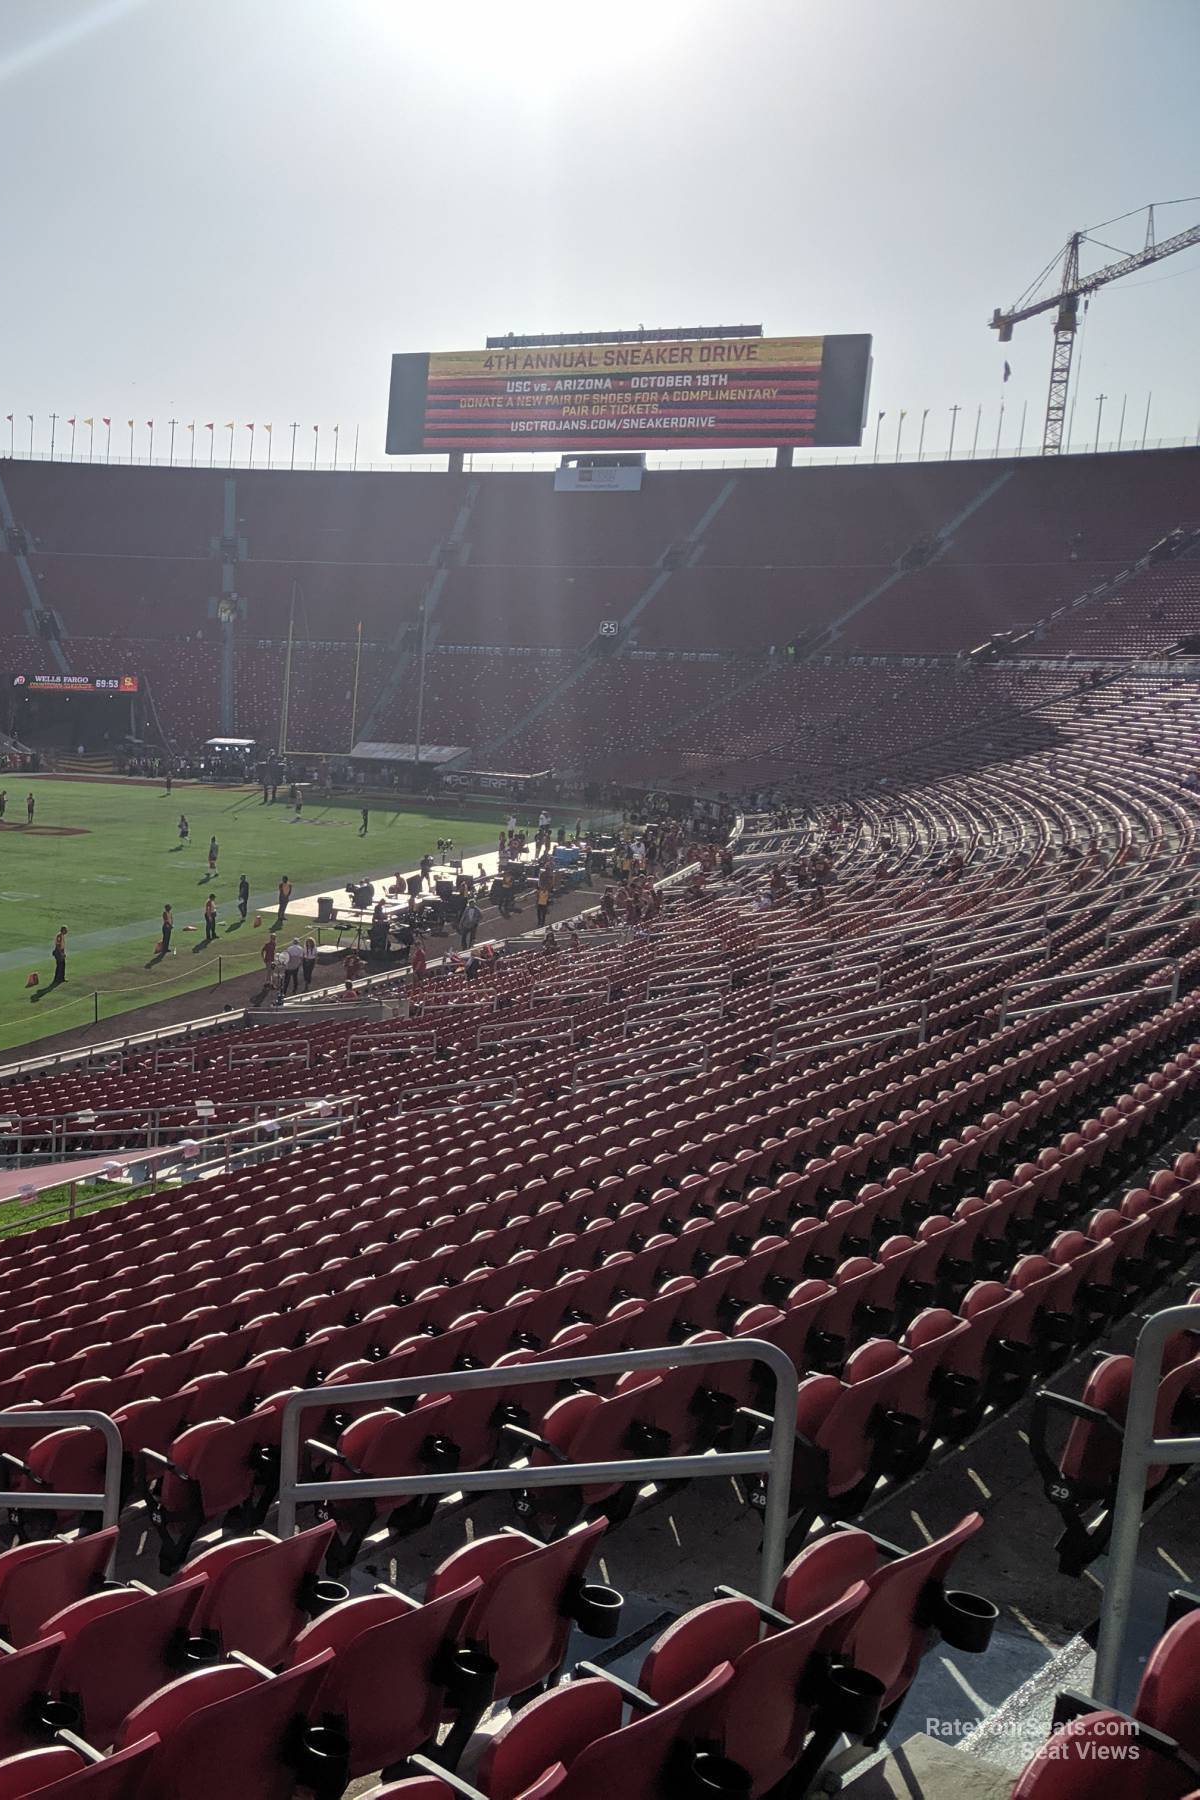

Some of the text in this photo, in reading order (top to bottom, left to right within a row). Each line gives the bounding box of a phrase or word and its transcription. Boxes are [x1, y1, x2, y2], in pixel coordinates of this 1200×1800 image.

[483, 344, 758, 370] 4TH ANNUAL SNEAKER DRIVE
[506, 374, 728, 393] USC vs. ARIZONA OCTOBER 19TH
[460, 388, 778, 409] DONATE A NEW PAIR OF SHOES FOR A COMPLIMENTARY
[562, 403, 662, 417] PAIR OF TICKETS.
[511, 416, 716, 432] USCTROJANS.COM/SNEAKERDRIVE
[602, 623, 615, 633] 25
[34, 675, 61, 683] WELLS
[95, 679, 119, 688] 69:53
[752, 1492, 766, 1505] 28
[1051, 1485, 1070, 1499] 29
[517, 1501, 530, 1512] 27
[318, 1509, 329, 1520] 26
